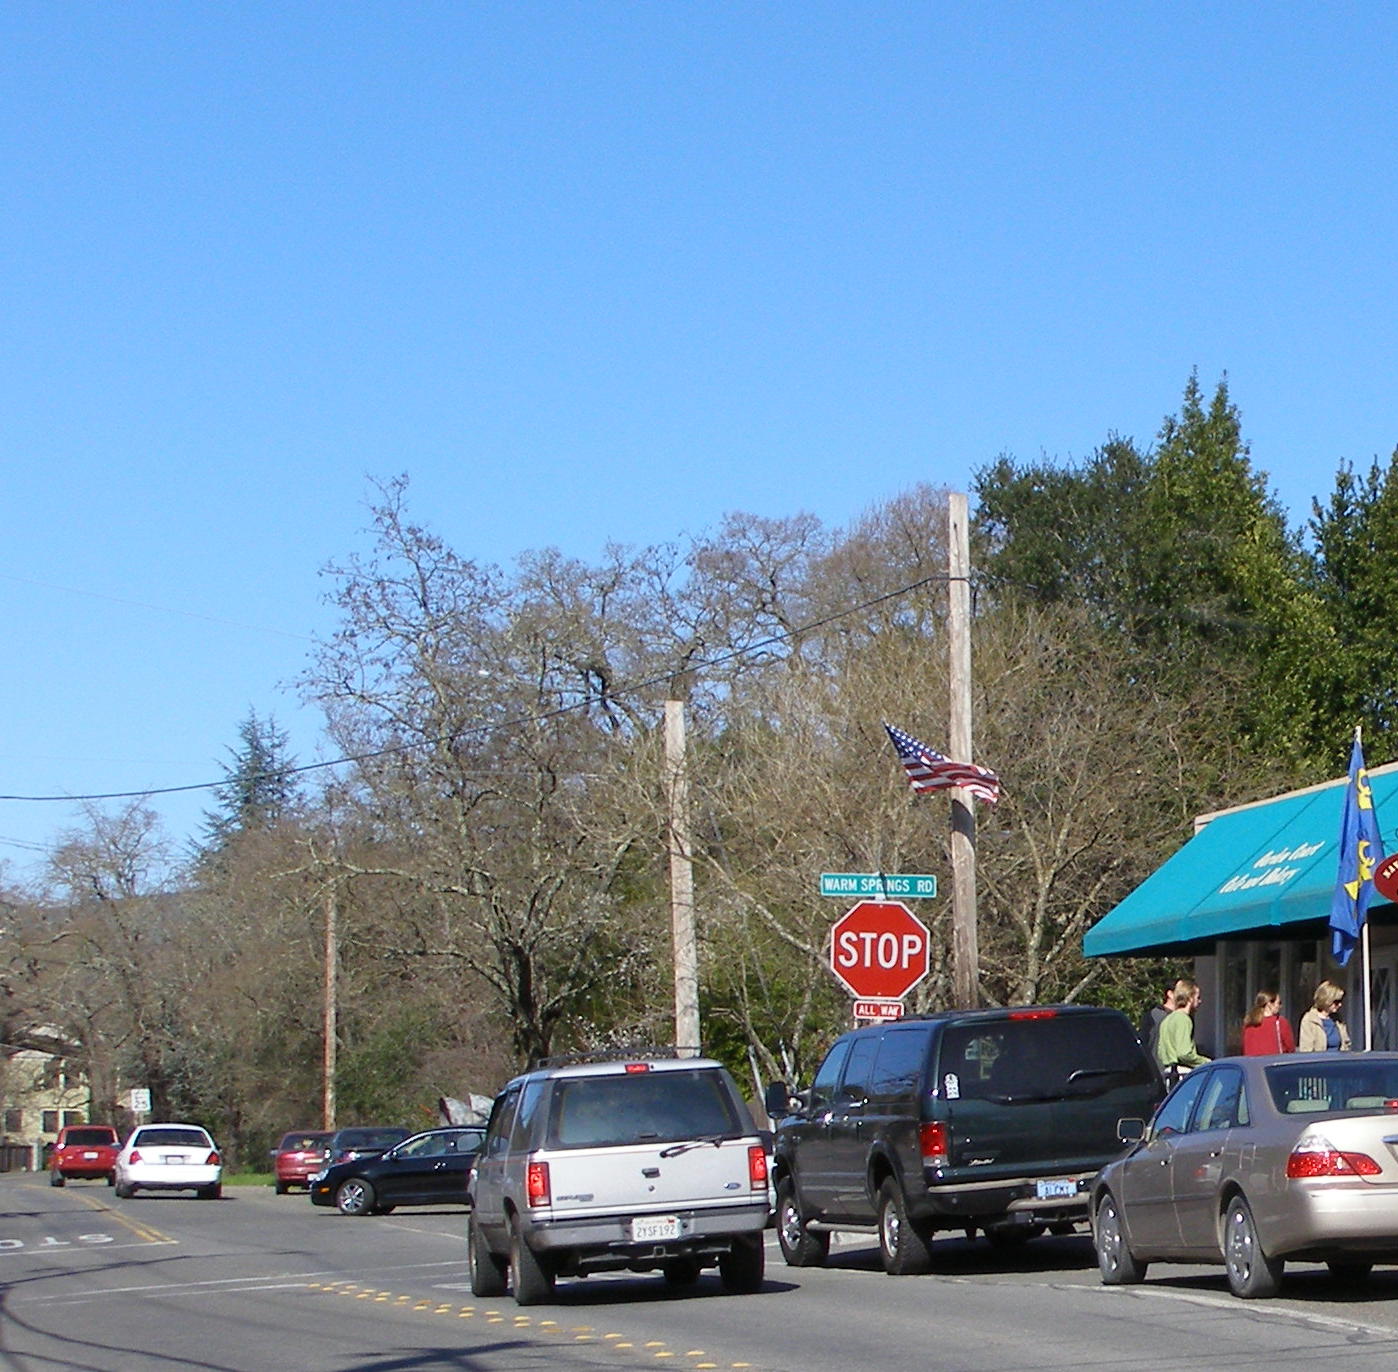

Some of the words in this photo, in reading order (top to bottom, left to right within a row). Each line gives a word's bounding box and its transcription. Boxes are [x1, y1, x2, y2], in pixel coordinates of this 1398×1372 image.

[824, 878, 858, 891] WARM
[917, 881, 933, 893] RD
[838, 931, 923, 969] STOP
[858, 1005, 876, 1016] ALL
[880, 1006, 899, 1017] WAY
